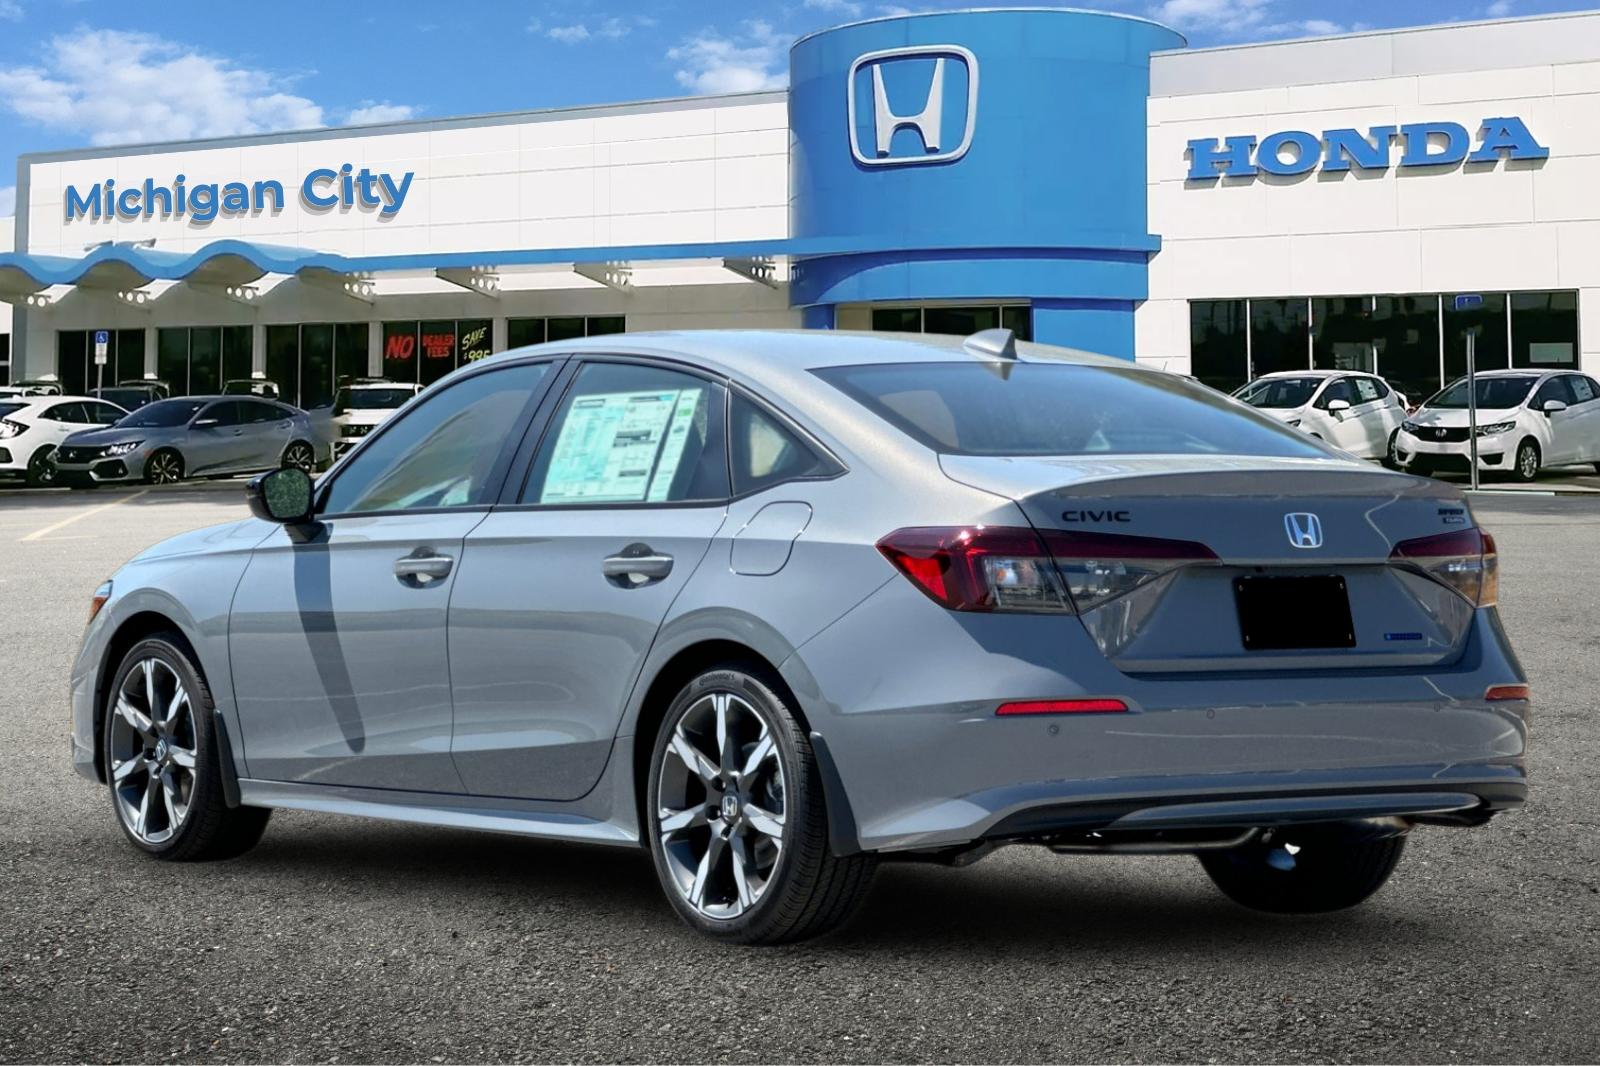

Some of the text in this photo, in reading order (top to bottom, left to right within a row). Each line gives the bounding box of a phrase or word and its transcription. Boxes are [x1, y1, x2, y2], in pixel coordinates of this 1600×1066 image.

[1187, 117, 1549, 183] HONDA
[66, 163, 414, 221] Michigan City
[386, 336, 414, 358] NO
[462, 327, 487, 350] SAVE
[1062, 510, 1132, 522] CIVIC
